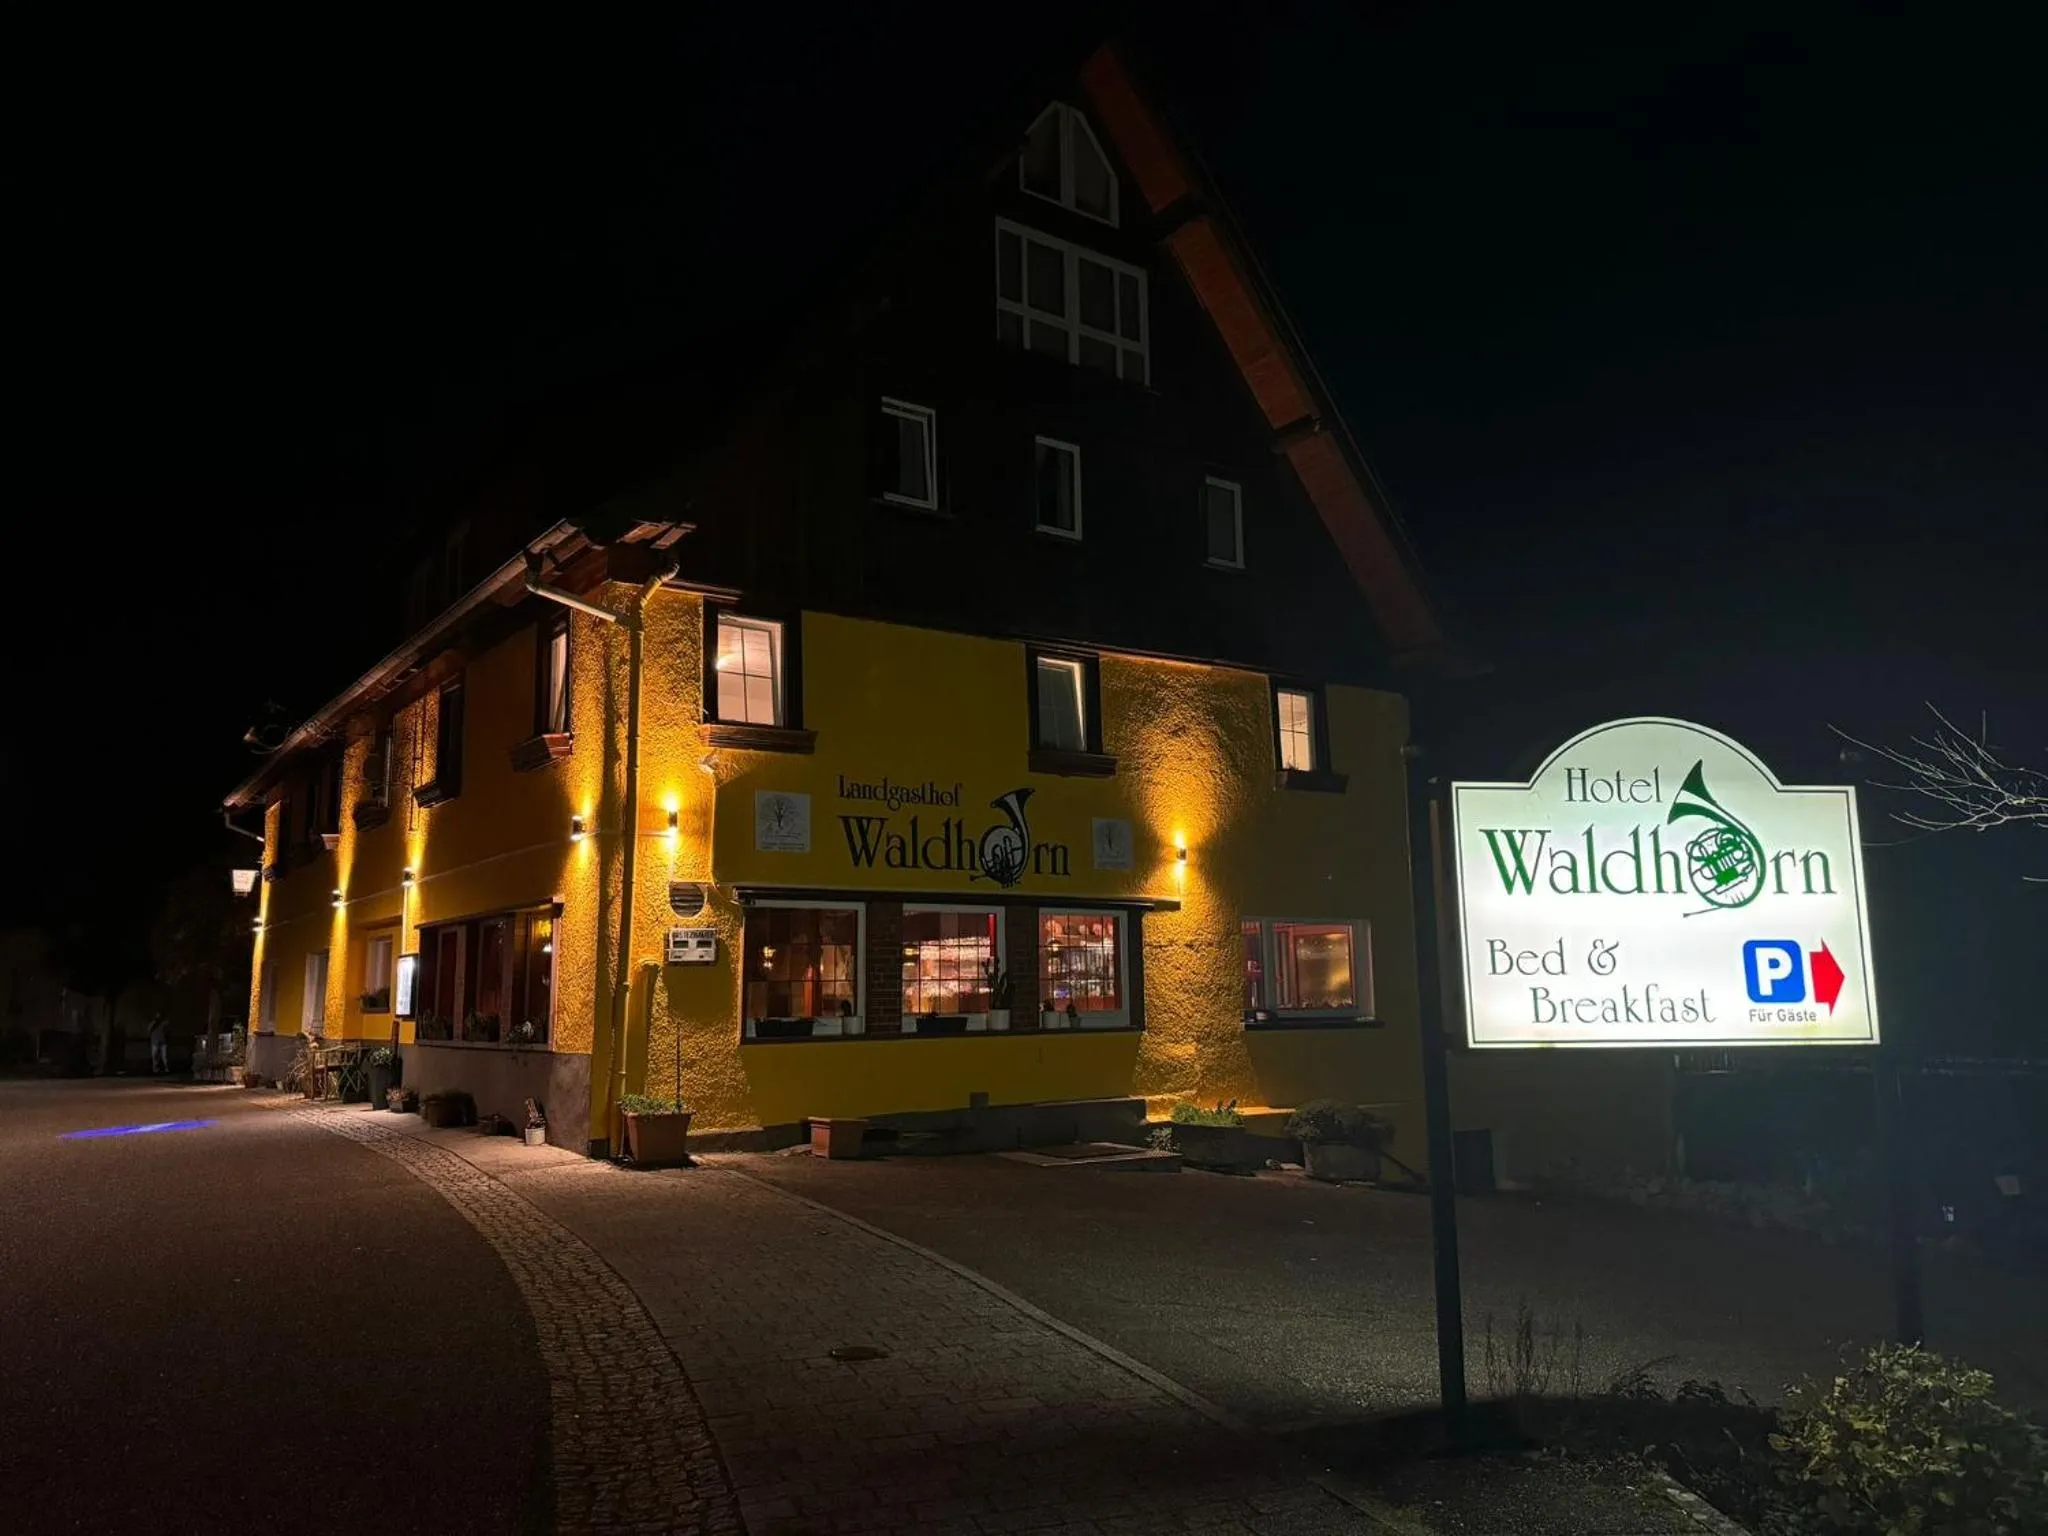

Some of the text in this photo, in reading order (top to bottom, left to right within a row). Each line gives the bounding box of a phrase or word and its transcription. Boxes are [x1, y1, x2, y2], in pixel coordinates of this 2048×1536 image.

[838, 775, 964, 811] Landgasthof
[1563, 765, 1664, 804] Hotel
[836, 810, 1072, 880] Waldhorn
[1478, 808, 1838, 908] Waldhorn
[1486, 936, 1620, 977] Bed &
[1755, 947, 1793, 996] P
[1529, 984, 1718, 1024] Breakfast
[1748, 1007, 1818, 1022] Für Gäste
